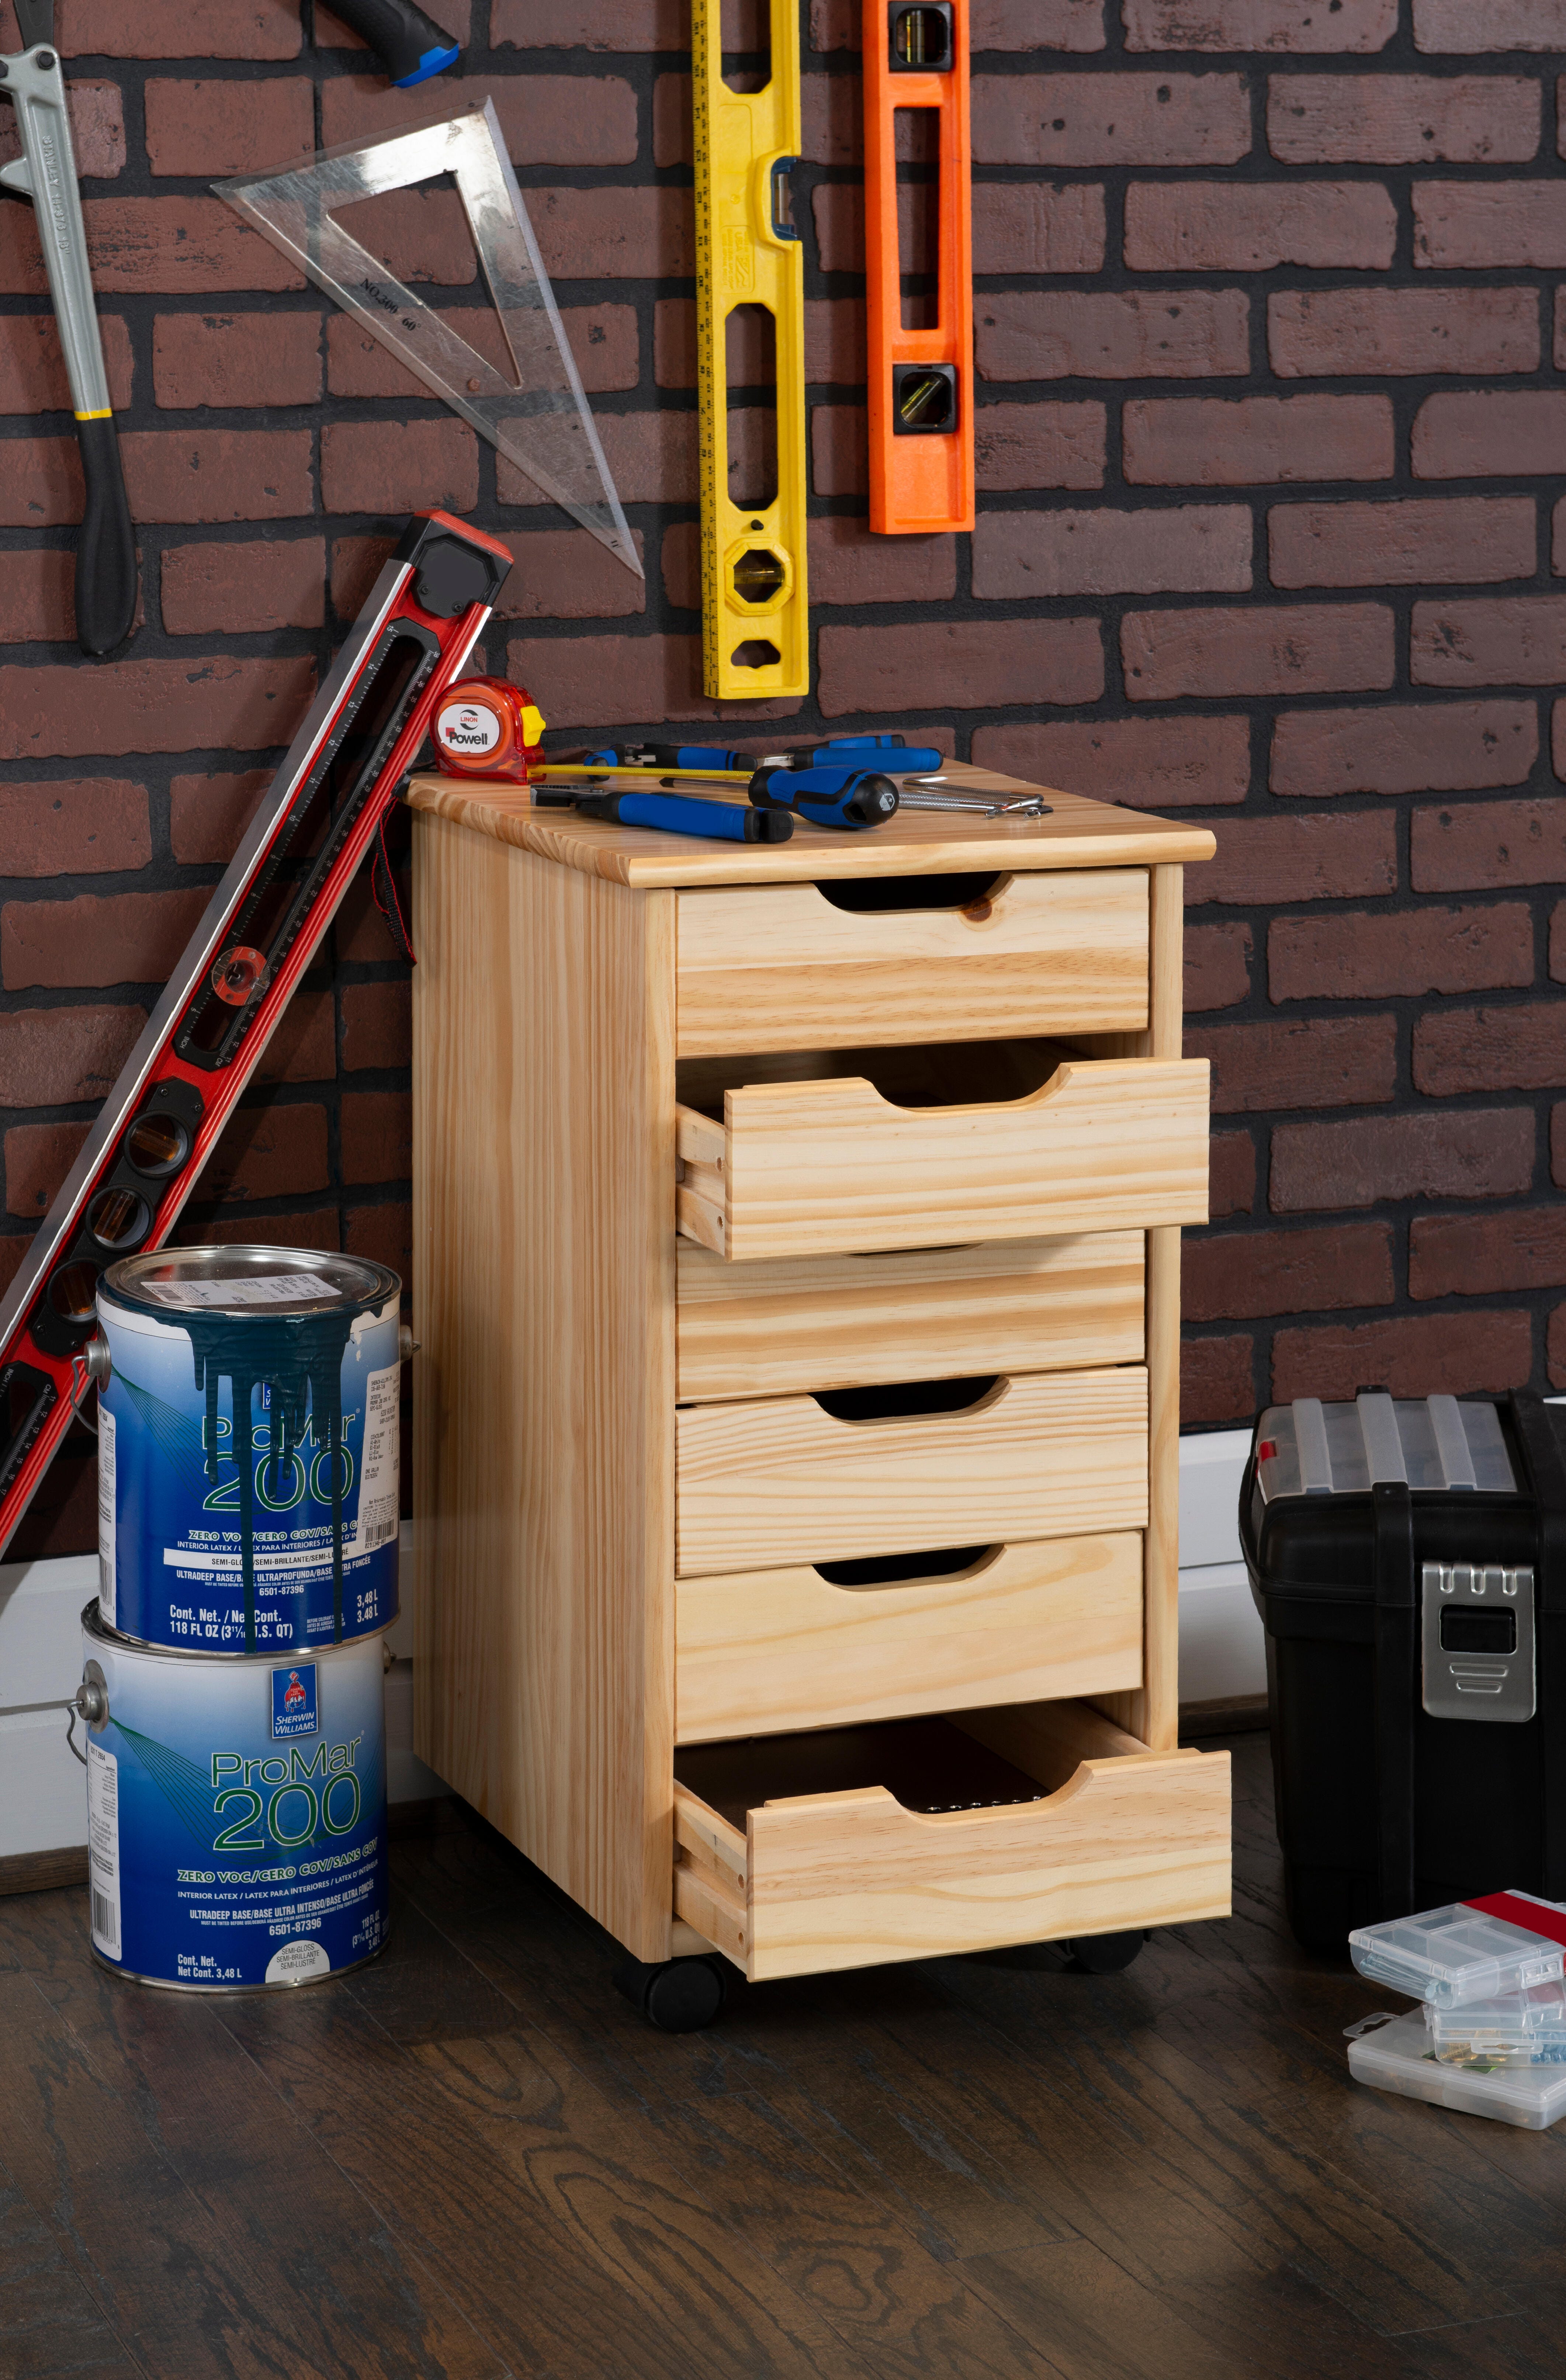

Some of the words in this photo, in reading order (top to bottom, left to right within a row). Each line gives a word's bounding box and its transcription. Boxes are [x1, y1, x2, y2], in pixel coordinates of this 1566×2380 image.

[43, 135, 60, 187] STANLEY
[449, 731, 488, 745] Powell
[179, 1036, 190, 1049] INCH
[215, 1057, 224, 1067] CM
[3, 1368, 14, 1383] INCH
[42, 1384, 51, 1394] CM
[203, 1445, 353, 1511] 200
[188, 1530, 220, 1541] ZERO
[222, 1531, 287, 1542] VO/CERO
[290, 1522, 348, 1540] COV/SAS
[177, 1541, 209, 1550] INTERIOR
[282, 1539, 321, 1550] INTERIORES
[176, 1570, 215, 1581] ULTRADEEP
[257, 1566, 333, 1582] ULTRAPROFUNDA/BASE
[352, 1555, 371, 1569] FONCÉE
[259, 1584, 304, 1596] 6501-87396
[357, 1591, 373, 1608] 3,48
[374, 1588, 378, 1601] L
[170, 1604, 196, 1620] Cont.
[199, 1608, 221, 1622] Net.
[224, 1610, 229, 1624] /
[232, 1610, 245, 1623] Ne
[254, 1610, 282, 1623] Cont.
[357, 1605, 373, 1623] 3.48
[374, 1603, 378, 1617] L
[170, 1620, 187, 1634] 118
[191, 1623, 203, 1636] FL
[205, 1624, 219, 1638] OZ
[276, 1623, 293, 1639] QT)
[275, 1711, 315, 1725] SHERWIN
[275, 1721, 315, 1734] WILLIAMS
[211, 1736, 361, 1788] ProMar
[213, 1770, 361, 1851] 200
[177, 1869, 215, 1883] ZERO
[216, 1866, 296, 1883] VOC/CERO
[299, 1848, 361, 1876] COV/SANS
[362, 1836, 378, 1857] COV
[177, 1891, 212, 1899] INTERIOR
[270, 1889, 289, 1898] PARA
[291, 1880, 329, 1895] INTERIORES
[335, 1874, 352, 1884] LATEX
[190, 1909, 231, 1920] ULTRADEEP
[232, 1908, 273, 1920] BASE/BASE
[274, 1905, 296, 1917] ULTRA
[297, 1894, 342, 1914] INTENSO/BASE
[342, 1887, 358, 1904] ULTRA
[358, 1878, 374, 1896] FONCÉE
[269, 1917, 322, 1936] 6501-87396
[276, 1950, 320, 1963] SEMI-BRILLANTE
[281, 1943, 315, 1955] SEMI-GLOSS
[177, 1954, 198, 1966] Cont.
[201, 1956, 217, 1967] Net.
[280, 1955, 316, 1971] SEMI-LUSTRÉ
[178, 1966, 191, 1977] Net
[193, 1967, 214, 1978] Cont.
[216, 1968, 235, 1980] 3,48
[237, 1968, 242, 1978] L
